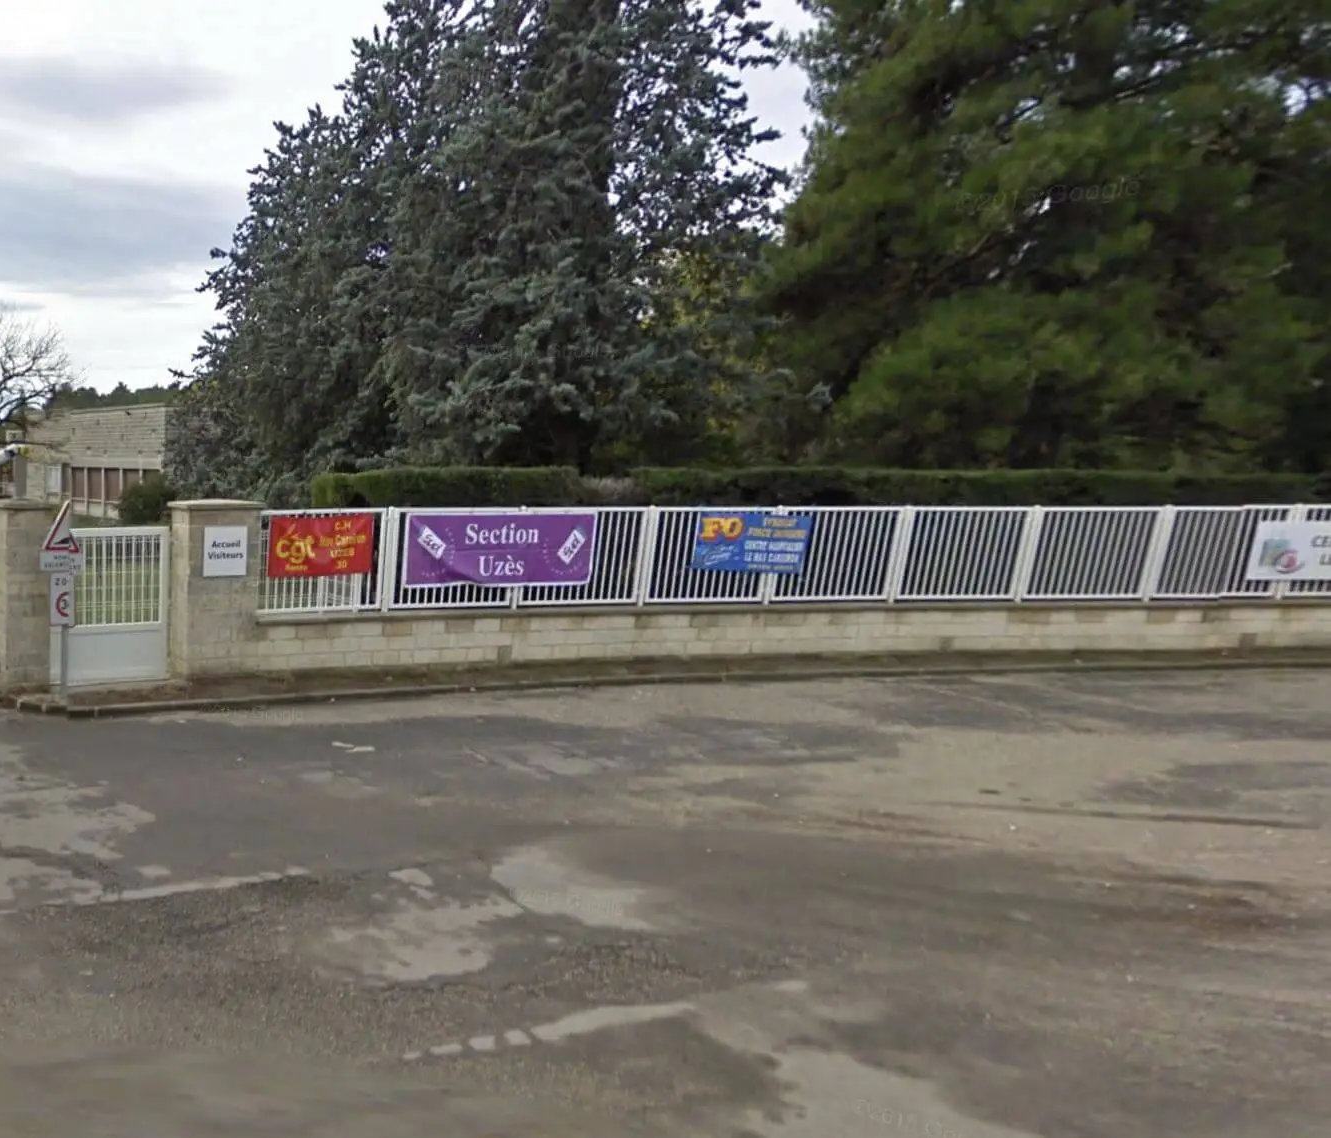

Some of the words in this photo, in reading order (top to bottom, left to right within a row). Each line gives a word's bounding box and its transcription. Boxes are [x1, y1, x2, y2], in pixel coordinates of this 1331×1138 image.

[465, 523, 539, 545] Section
[700, 517, 743, 541] FO
[207, 551, 244, 560] Visiteurs
[211, 540, 241, 549] Accueil
[276, 535, 316, 564] cgt
[479, 555, 524, 577] Uzès
